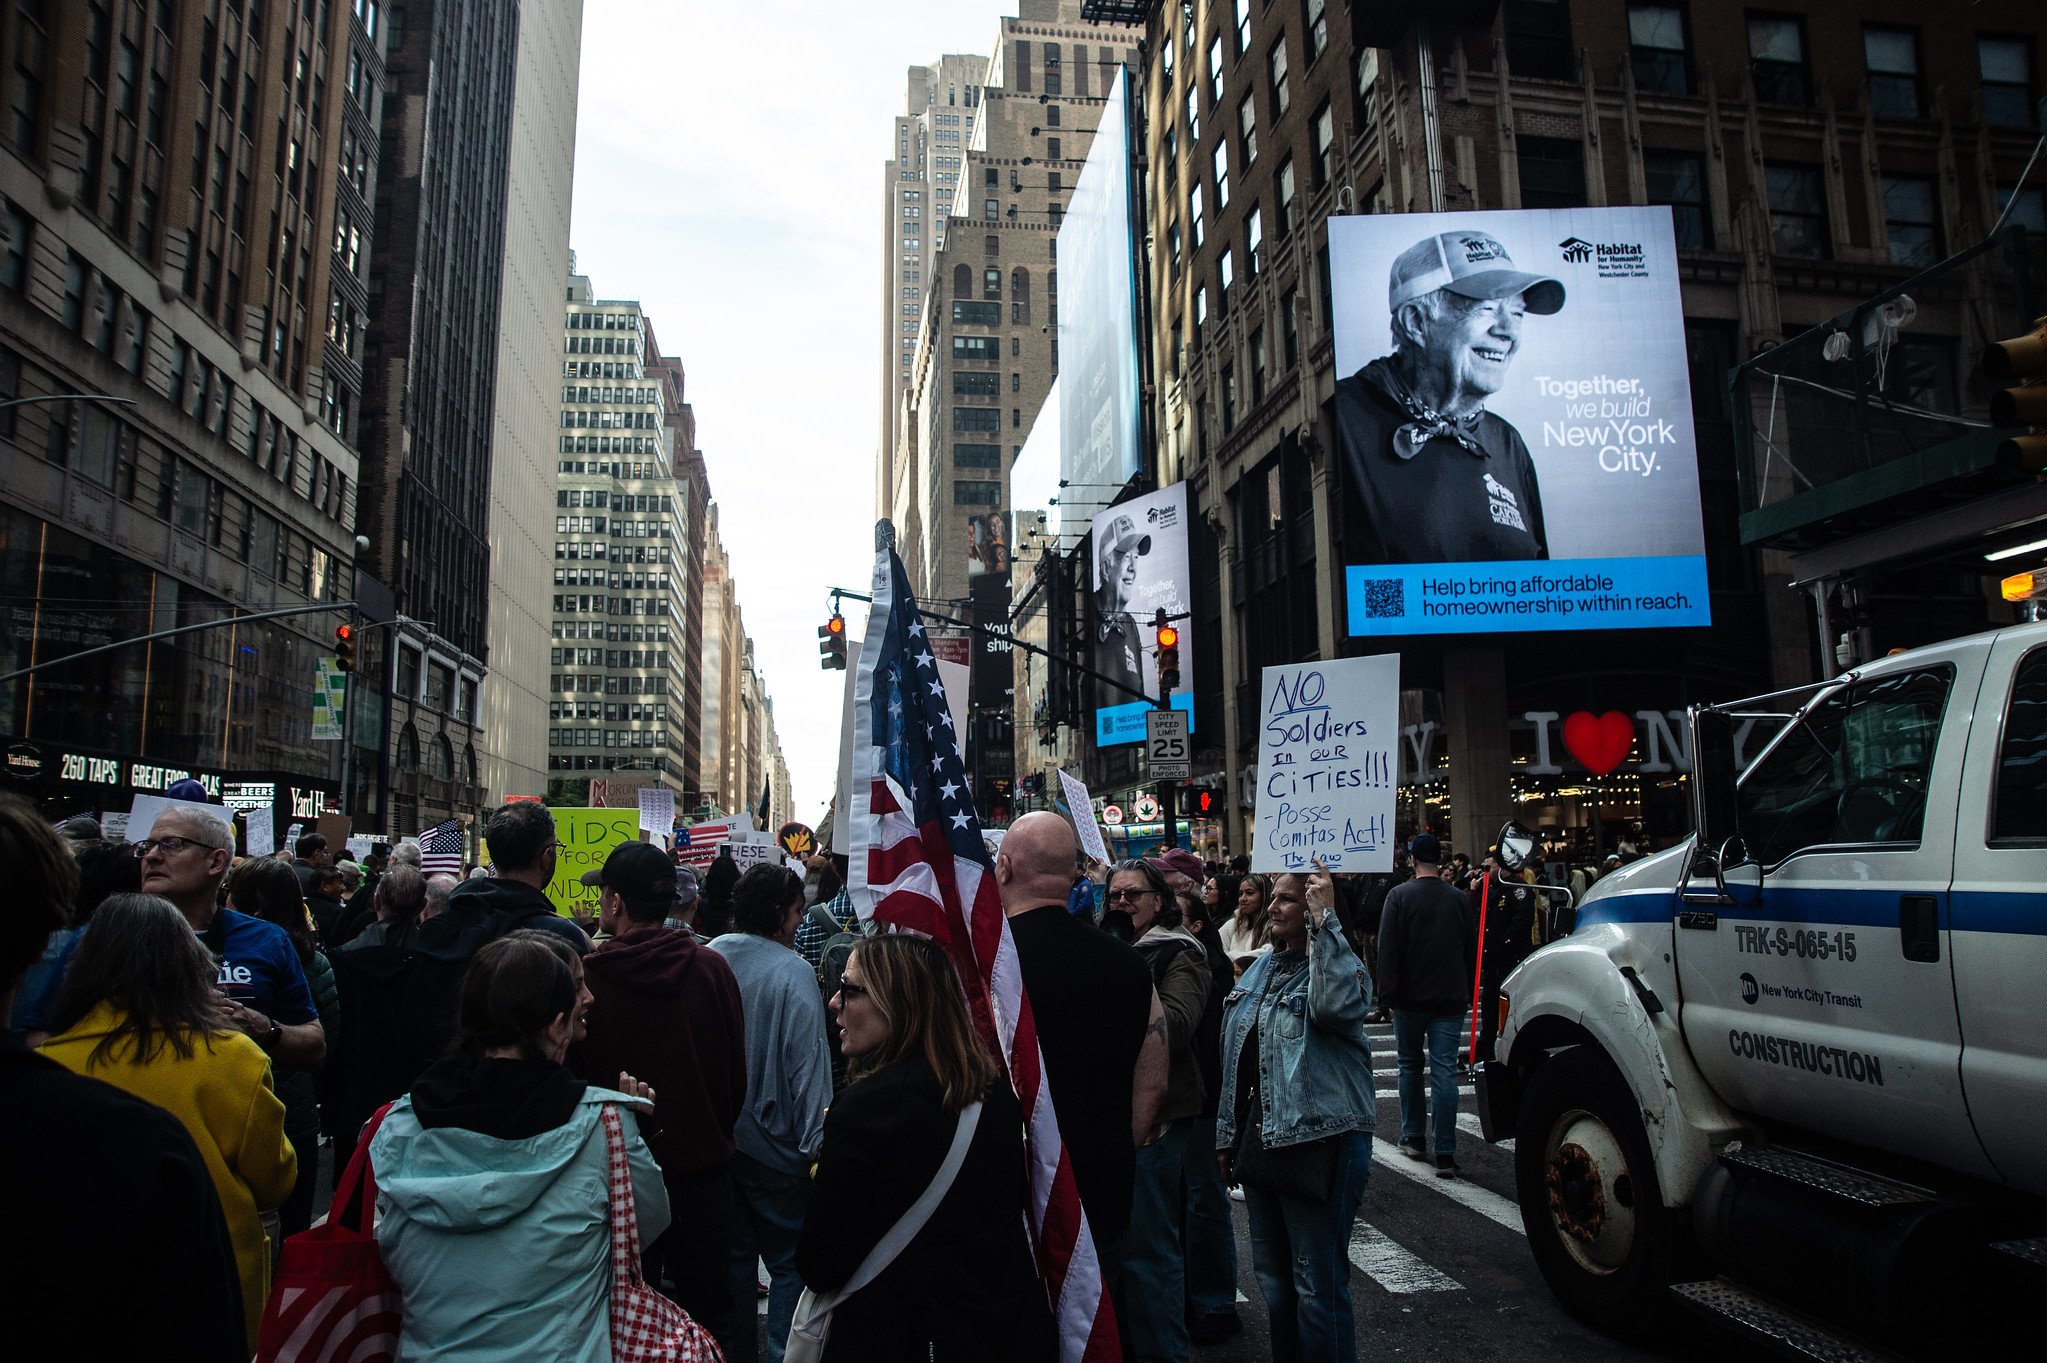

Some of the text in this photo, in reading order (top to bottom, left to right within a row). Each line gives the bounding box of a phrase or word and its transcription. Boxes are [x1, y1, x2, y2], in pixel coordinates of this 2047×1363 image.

[1596, 243, 1643, 255] Habitat
[1609, 255, 1643, 263] Humanity
[1536, 374, 1645, 400] Together,
[1566, 396, 1651, 419] we build
[1544, 420, 1676, 448] New York
[1598, 446, 1662, 477] City.
[1139, 580, 1175, 598] Together,
[1423, 574, 1613, 599] Help bring affordable
[1423, 593, 1692, 619] homeownership within reach.
[984, 622, 1008, 636] You
[934, 639, 960, 647] Standing
[987, 638, 1013, 653] ship
[1268, 670, 1325, 713] NO
[1266, 710, 1368, 748] Soldiers
[1153, 738, 1185, 758] 25
[1401, 721, 1441, 785] Y
[1525, 711, 1563, 775] I
[61, 753, 85, 782] 260
[88, 757, 118, 785] TAPS
[131, 763, 164, 790] GREAT
[241, 787, 275, 796] BEERS
[593, 778, 646, 798] MORON
[222, 800, 273, 809] TOGETHER
[290, 787, 314, 819] Yard
[569, 816, 632, 848] iDS
[1269, 813, 1385, 851] Comitas Act!
[564, 850, 606, 866] FOR
[731, 845, 768, 860] HESE
[1281, 849, 1342, 863] The Law
[1734, 925, 1857, 963] TRK-S-065-15
[221, 960, 252, 984] ie
[1761, 983, 1863, 1009] New York City Transit
[1729, 1029, 1885, 1088] CONSTRUCTION
